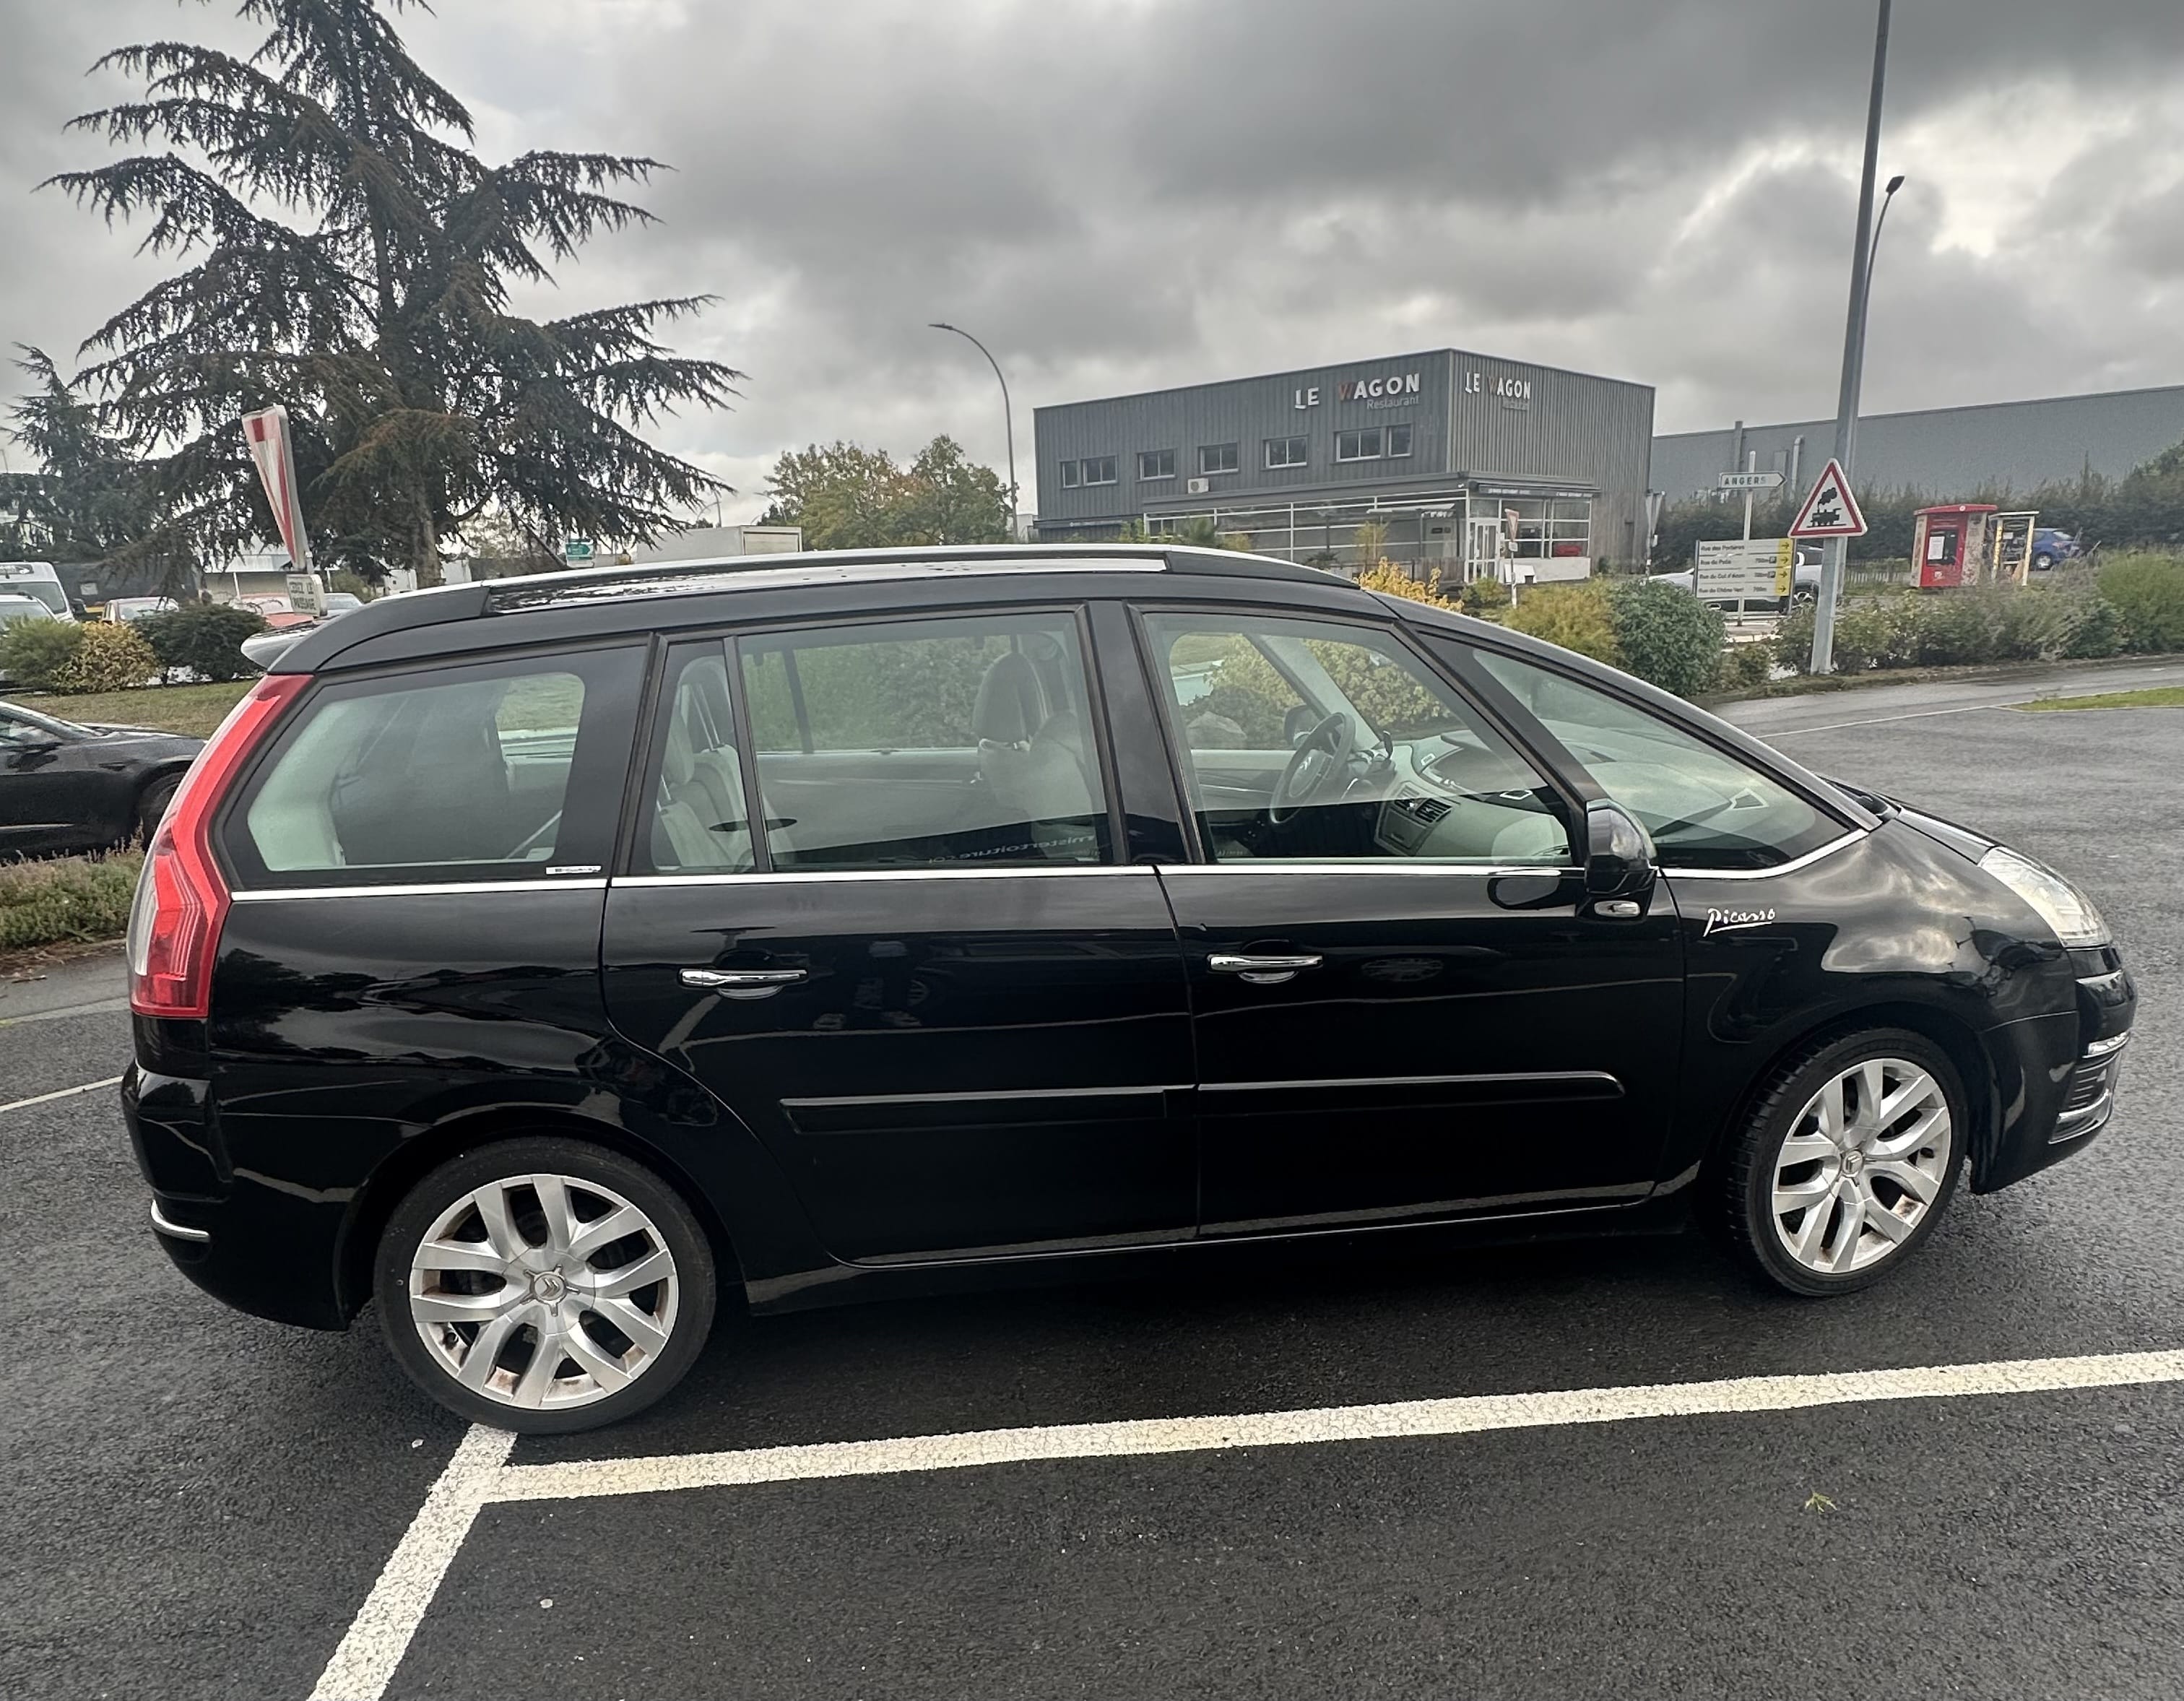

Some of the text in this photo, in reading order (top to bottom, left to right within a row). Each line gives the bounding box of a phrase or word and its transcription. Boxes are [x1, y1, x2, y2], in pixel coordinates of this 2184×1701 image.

[1294, 373, 1421, 409] LE WAGON
[1465, 371, 1531, 399] LE WAGON
[1366, 394, 1420, 410] Restaurant
[1703, 907, 1776, 938] Picasso
